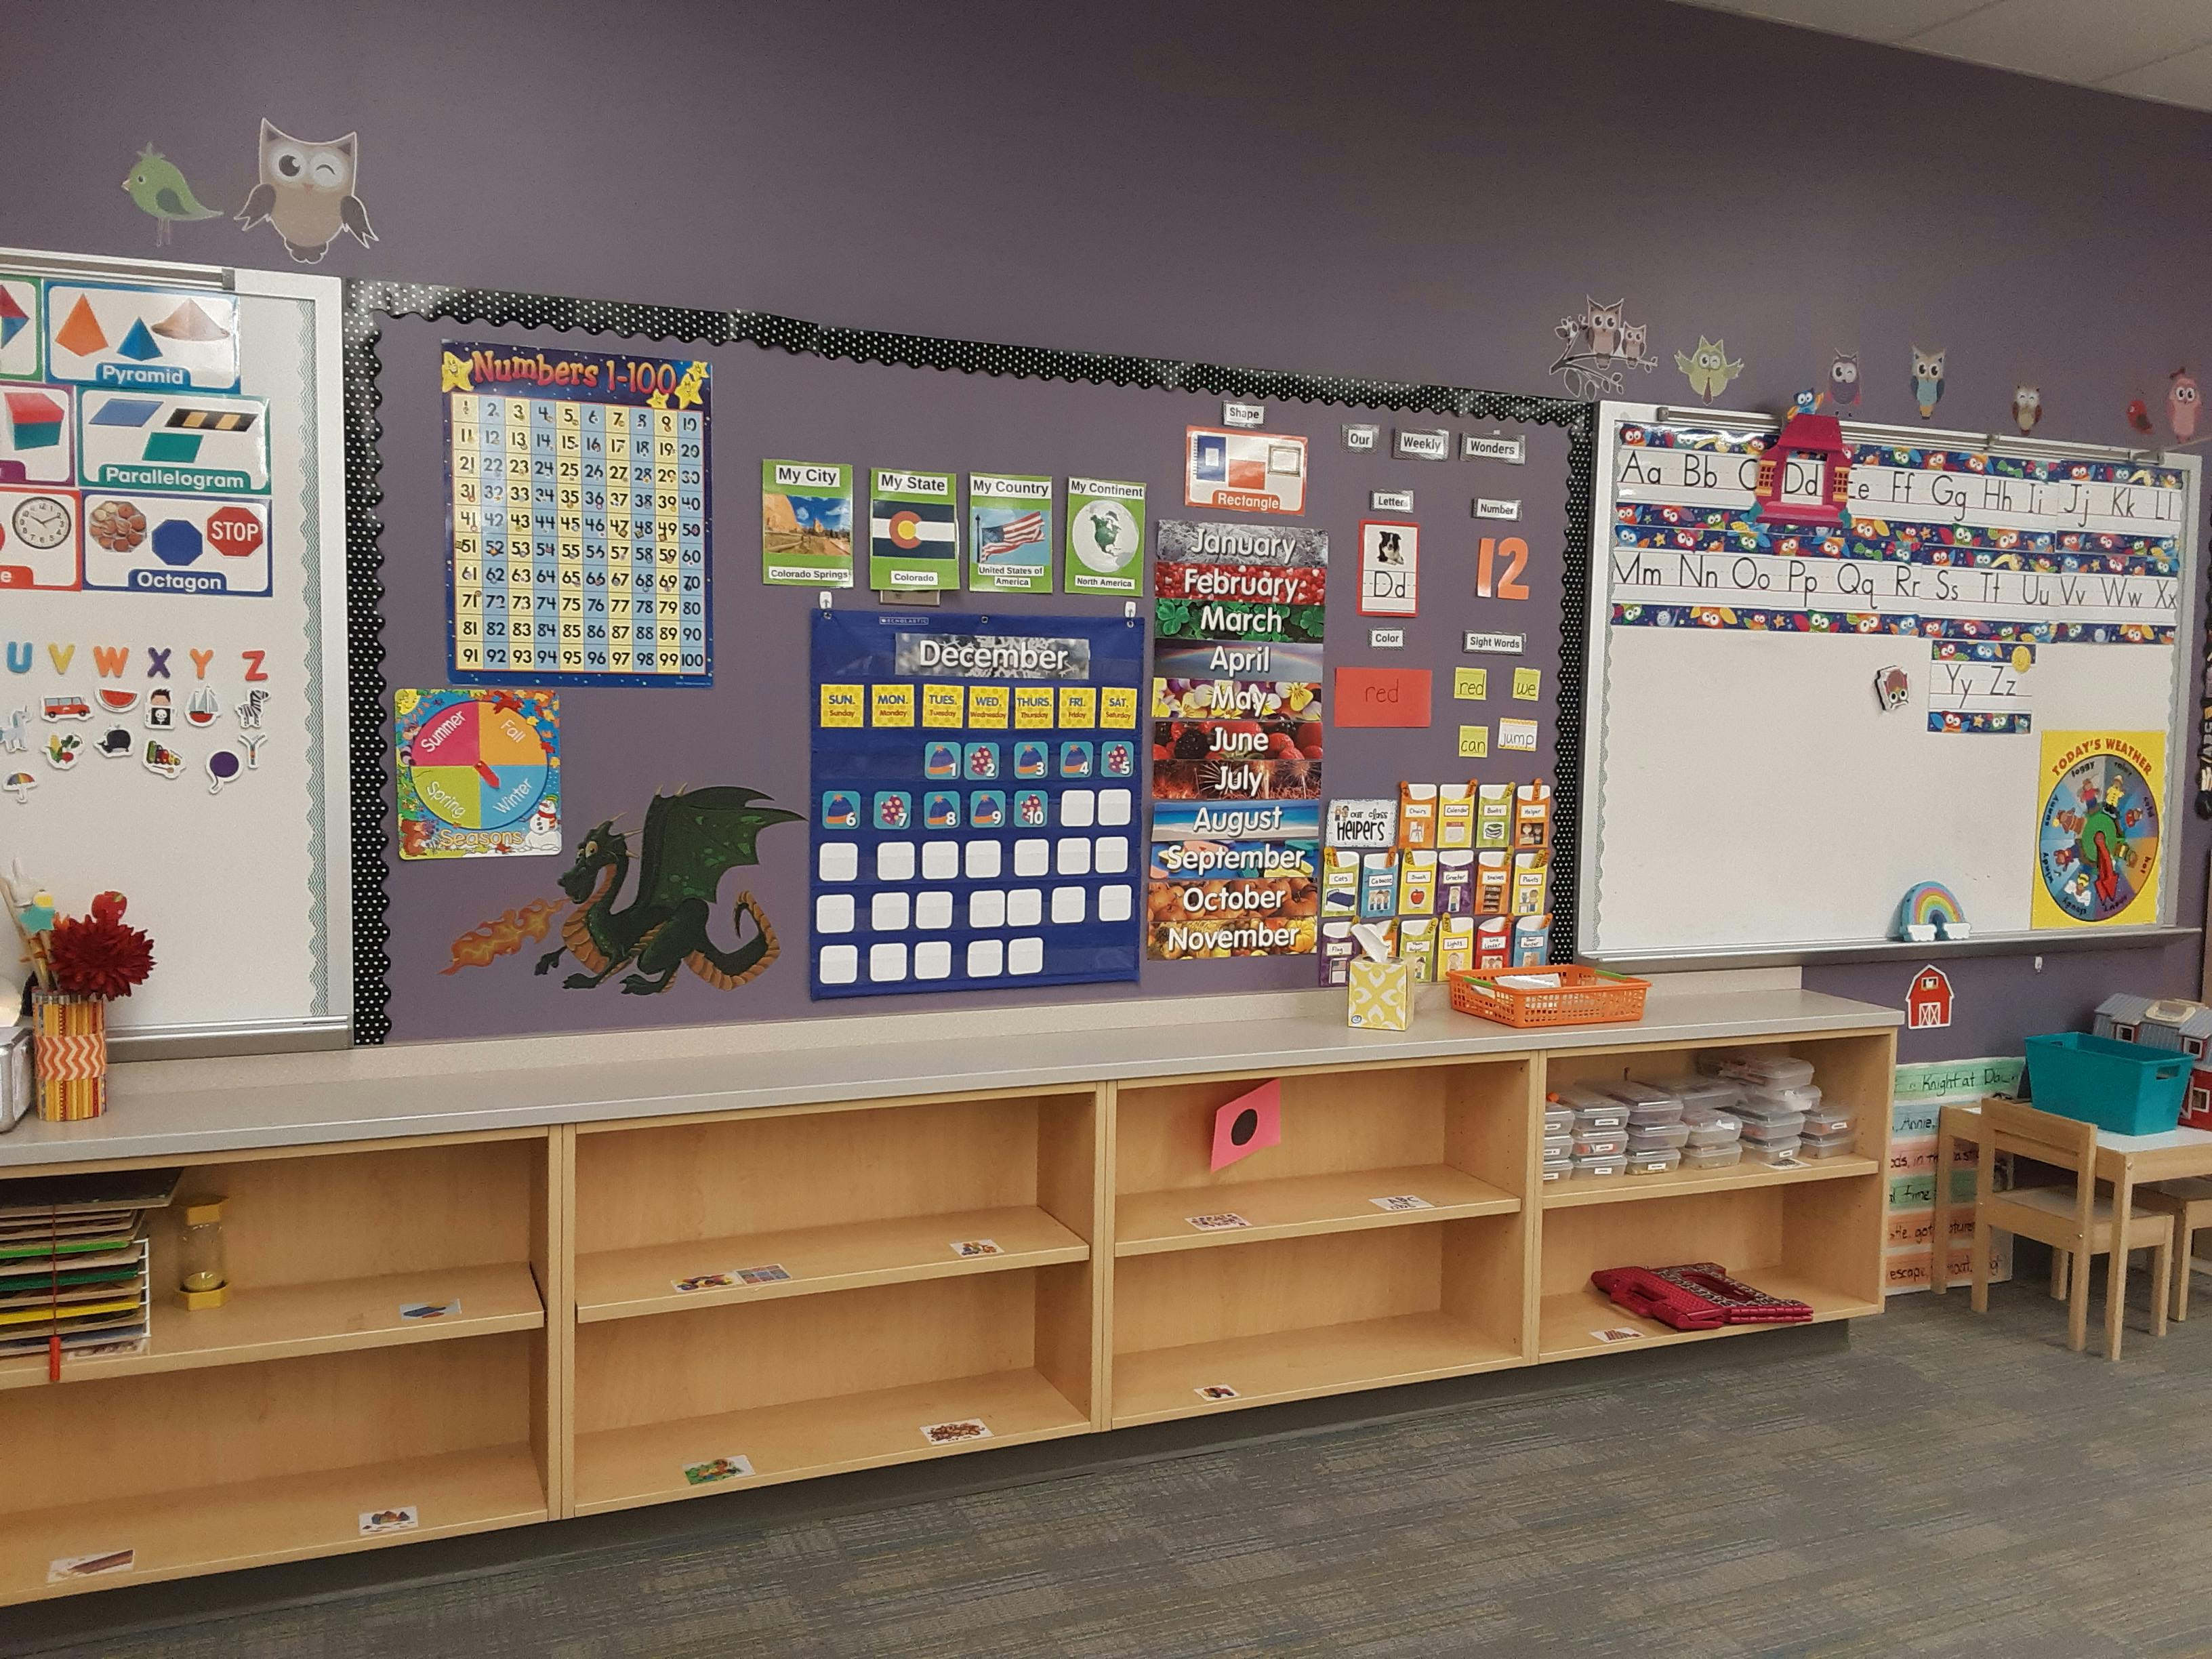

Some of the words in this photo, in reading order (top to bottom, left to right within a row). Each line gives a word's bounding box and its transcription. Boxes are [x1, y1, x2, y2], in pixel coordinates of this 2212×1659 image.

[102, 365, 184, 386] Pyramid
[471, 350, 598, 388] Numbers
[607, 361, 676, 394] 1-100
[1229, 407, 1259, 419] Shape
[1351, 433, 1370, 446] Our
[1404, 437, 1441, 453] Weekly
[1471, 441, 1515, 455] Wonders
[106, 467, 245, 489] Parallelogram
[779, 467, 800, 482] My
[806, 469, 837, 485] City
[881, 474, 901, 490] My
[907, 476, 945, 491] State
[973, 480, 991, 494] My
[996, 480, 1049, 497] Country
[1071, 480, 1086, 493] My
[1089, 483, 1143, 497] Continent
[1621, 450, 1662, 485] Aa
[1684, 454, 1717, 488] Bb
[1738, 459, 1758, 491] C
[1784, 462, 1818, 495] Dd
[1892, 470, 1914, 504] Ff
[1932, 475, 1967, 521] Gg
[1984, 479, 2012, 511] Hh
[2064, 484, 2090, 527] Jj
[2112, 487, 2135, 517] Kk
[1218, 493, 1279, 511] Rectangle
[1378, 496, 1404, 507] Letter
[1480, 504, 1514, 515] Number
[211, 520, 259, 541] STOP
[1191, 528, 1296, 564] January
[771, 569, 811, 578] Colorado
[813, 571, 848, 580] Springs
[894, 573, 934, 581] Colorado
[979, 566, 1004, 575] United
[1477, 537, 1529, 600] 12
[137, 571, 222, 592] Octagon
[996, 577, 1029, 586] America
[1077, 577, 1098, 586] North
[1100, 579, 1132, 587] America
[1185, 569, 1298, 603] February
[1374, 571, 1406, 597] Dd
[1680, 554, 1718, 588] Nn
[1732, 557, 1770, 590] Oo
[1788, 560, 1818, 607] Pp
[1837, 563, 1878, 609] Qq
[1896, 565, 1921, 596] Rr
[1936, 570, 1959, 600] Ss
[2022, 575, 2049, 605] Uu
[2061, 577, 2085, 606] Vv
[2101, 577, 2143, 607] Ww
[1200, 605, 1282, 633] March
[1376, 634, 1399, 643] Color
[1470, 637, 1491, 648] Sight
[1494, 638, 1519, 649] Words
[7, 641, 33, 674] U
[48, 642, 75, 674] V
[93, 646, 129, 677] W
[148, 647, 171, 678] X
[190, 649, 213, 679] Y
[242, 650, 268, 681] Z
[463, 649, 478, 663] 91
[487, 649, 506, 663] 92
[513, 650, 532, 663] 93
[537, 651, 557, 664] 94
[562, 651, 581, 665] 95
[588, 651, 606, 665] 96
[612, 652, 630, 665] 97
[636, 653, 654, 666] 98
[659, 653, 678, 667] 99
[681, 653, 703, 668] 100
[920, 639, 1069, 670] December
[1210, 646, 1269, 677] April
[1365, 678, 1399, 703] red
[1459, 674, 1486, 696] red
[1517, 682, 1536, 697] we
[1945, 665, 1972, 709] Yy
[1990, 665, 2016, 696] Zz
[828, 694, 855, 705] SUN.
[878, 695, 908, 705] MON.
[929, 695, 957, 705] TUES.
[975, 696, 1002, 706] WED.
[1017, 696, 1052, 707] THURS.
[1069, 697, 1085, 707] FRI.
[1109, 697, 1128, 707] SAT.
[1211, 685, 1268, 717] May
[829, 710, 855, 718] Sunday
[880, 710, 907, 718] Monday
[929, 710, 956, 718] Tuesday
[970, 710, 1006, 718] Wednesday
[1021, 711, 1048, 719] Thursday
[1068, 711, 1086, 719] Friday
[1105, 711, 1131, 719] Saturday
[421, 710, 466, 752] Summer
[500, 719, 526, 743] Fall
[1210, 727, 1269, 752] June
[1500, 731, 1534, 750] jump
[1460, 739, 1486, 753] can
[2052, 739, 2101, 776] TODAY'S
[2105, 738, 2152, 776] WEATHER
[949, 762, 957, 777] 1
[986, 764, 996, 777] 2
[1036, 762, 1044, 776] 3
[1079, 762, 1089, 775] 4
[1121, 761, 1130, 775] 5
[2071, 761, 2095, 777] foggy
[1214, 764, 1263, 796] July
[427, 781, 466, 819] Spring
[493, 778, 532, 814] Winter
[846, 813, 856, 826] 6
[898, 813, 907, 826] 7
[946, 813, 956, 825] 8
[991, 812, 1002, 825] 9
[1029, 811, 1044, 825] 10
[1193, 806, 1282, 836] August
[1368, 808, 1389, 820] class
[440, 829, 523, 846] Seasons
[1166, 844, 1305, 876] September
[1183, 884, 1286, 912] October
[1168, 922, 1300, 951] November
[1922, 1073, 1961, 1097] Knight
